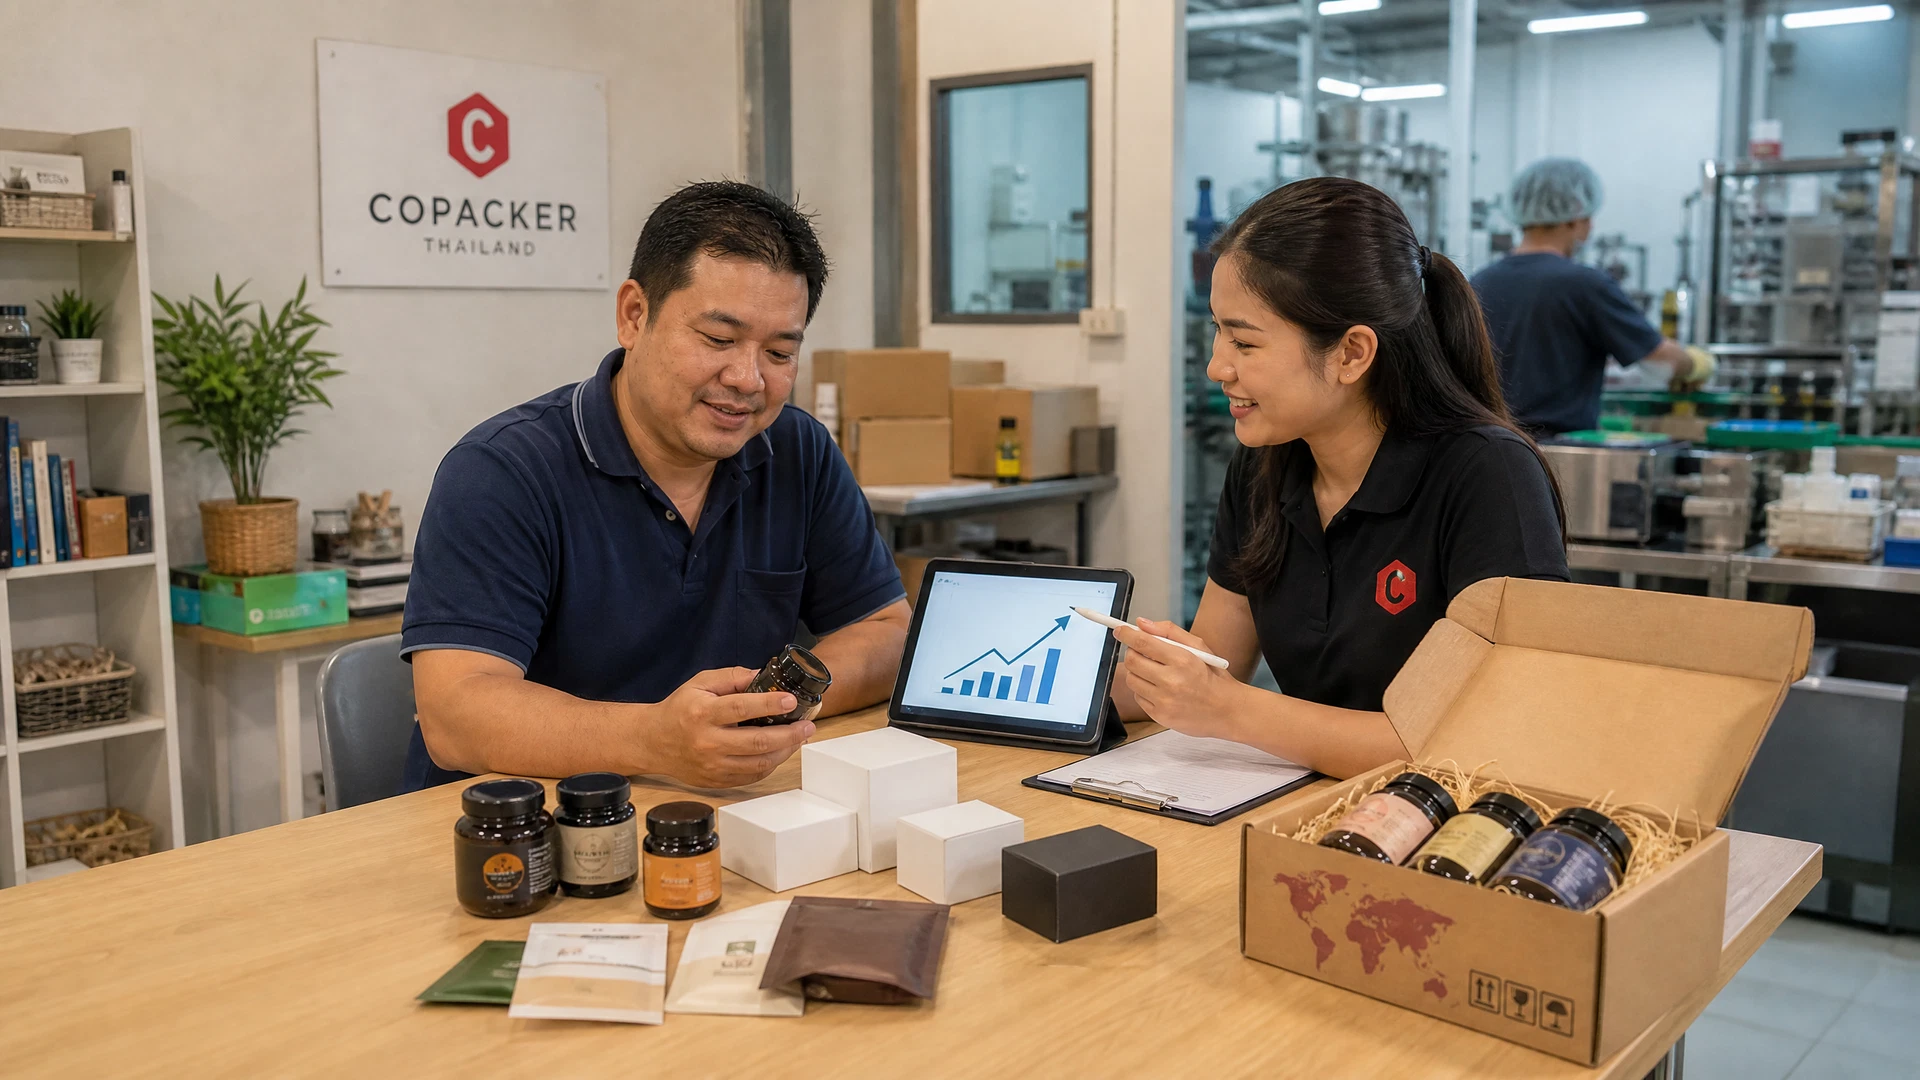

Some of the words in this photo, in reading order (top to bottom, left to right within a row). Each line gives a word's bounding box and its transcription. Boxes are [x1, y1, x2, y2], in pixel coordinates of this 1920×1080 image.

[461, 108, 496, 164] C
[369, 193, 577, 232] COPACKER
[423, 237, 536, 257] THAILAND
[1385, 569, 1406, 604] C
